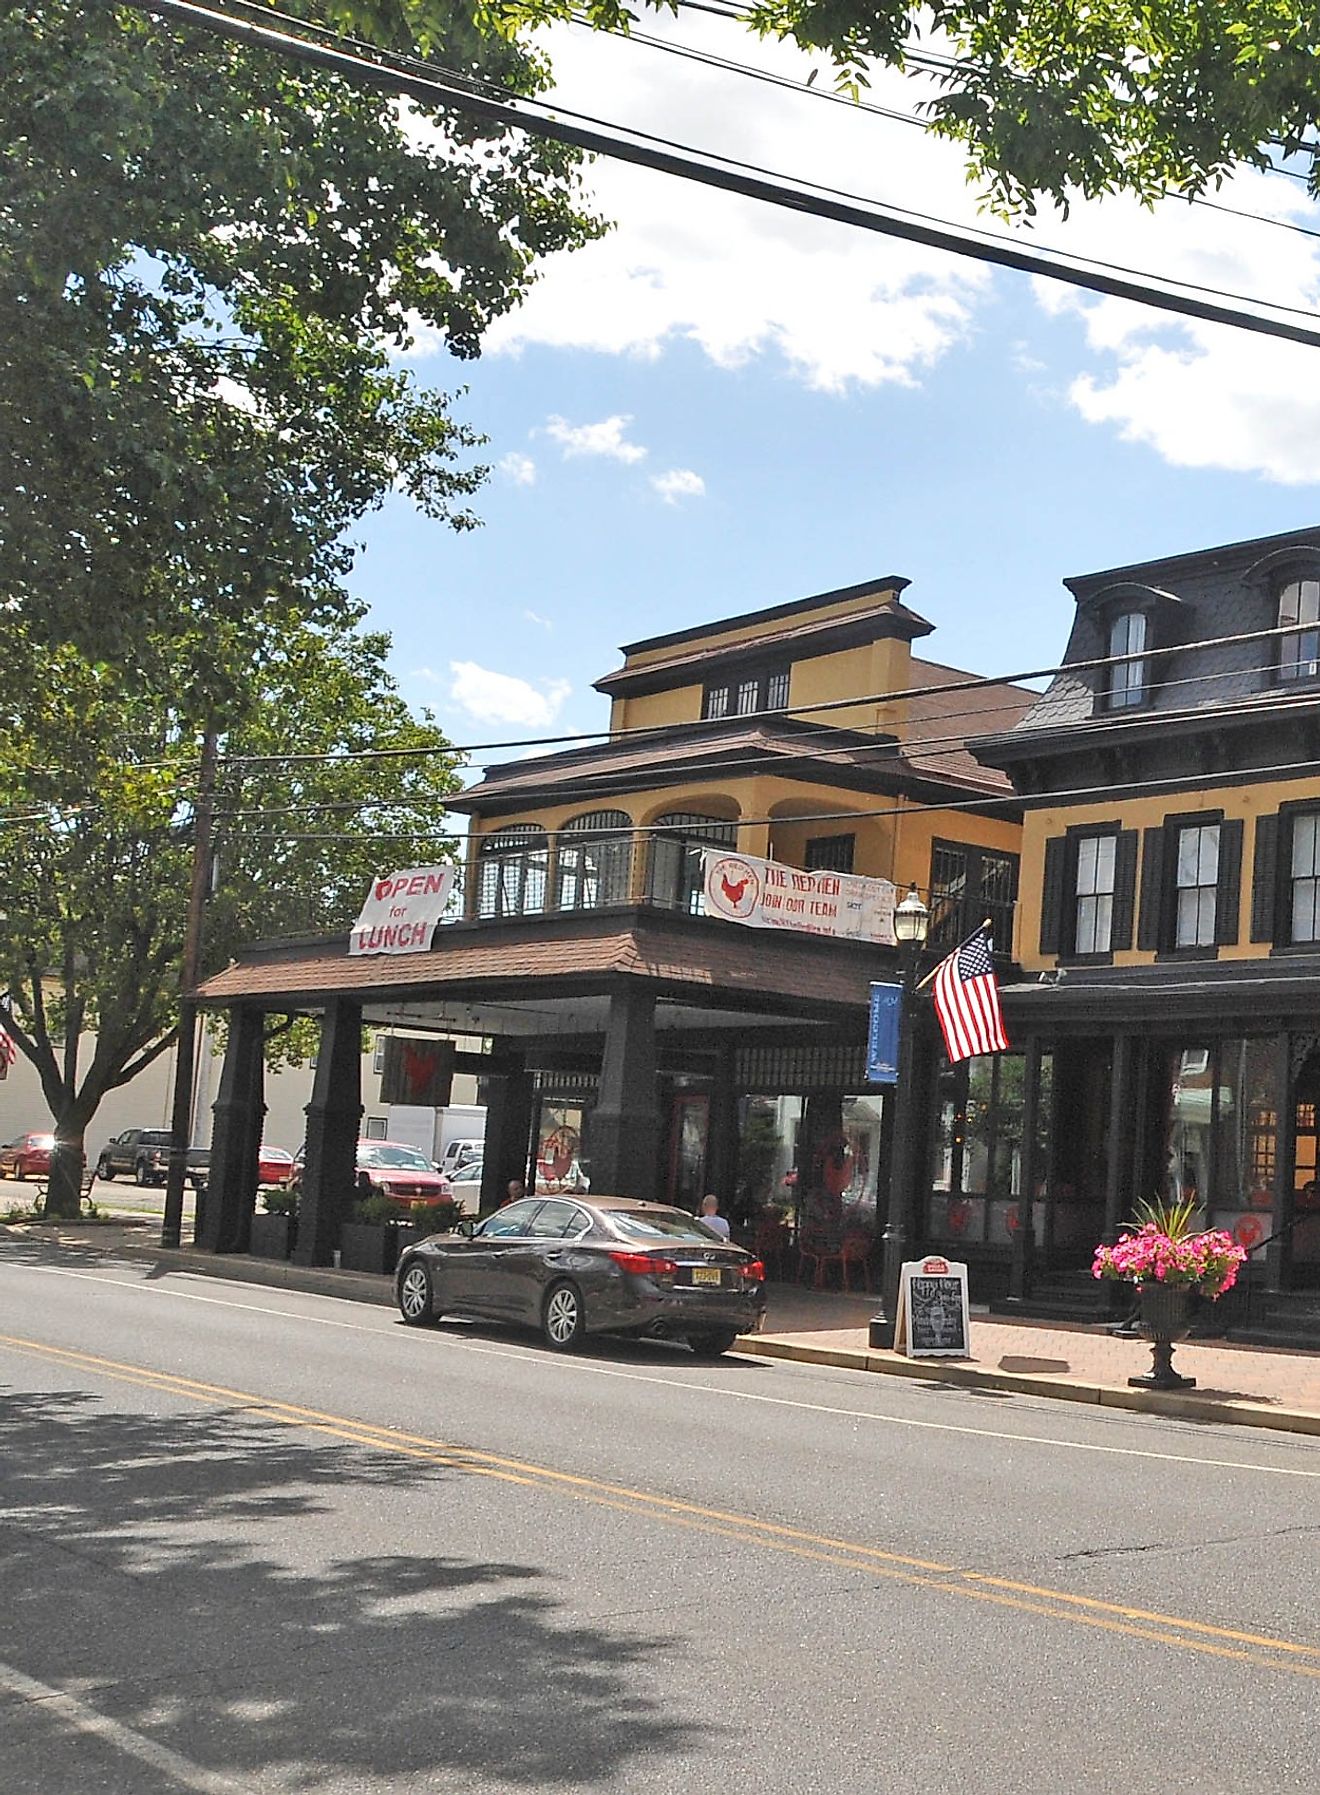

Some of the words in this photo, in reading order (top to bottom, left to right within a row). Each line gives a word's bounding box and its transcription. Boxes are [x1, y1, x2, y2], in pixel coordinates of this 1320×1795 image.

[375, 872, 445, 901] OPEN
[765, 867, 787, 888] THE
[791, 873, 817, 892] RED
[816, 877, 841, 896] HEN
[389, 905, 408, 918] for
[760, 892, 782, 909] JOIN
[786, 897, 805, 913] OUR
[809, 901, 838, 918] TEAM
[358, 922, 428, 950] LUNCH
[871, 993, 880, 1063] WELCOME
